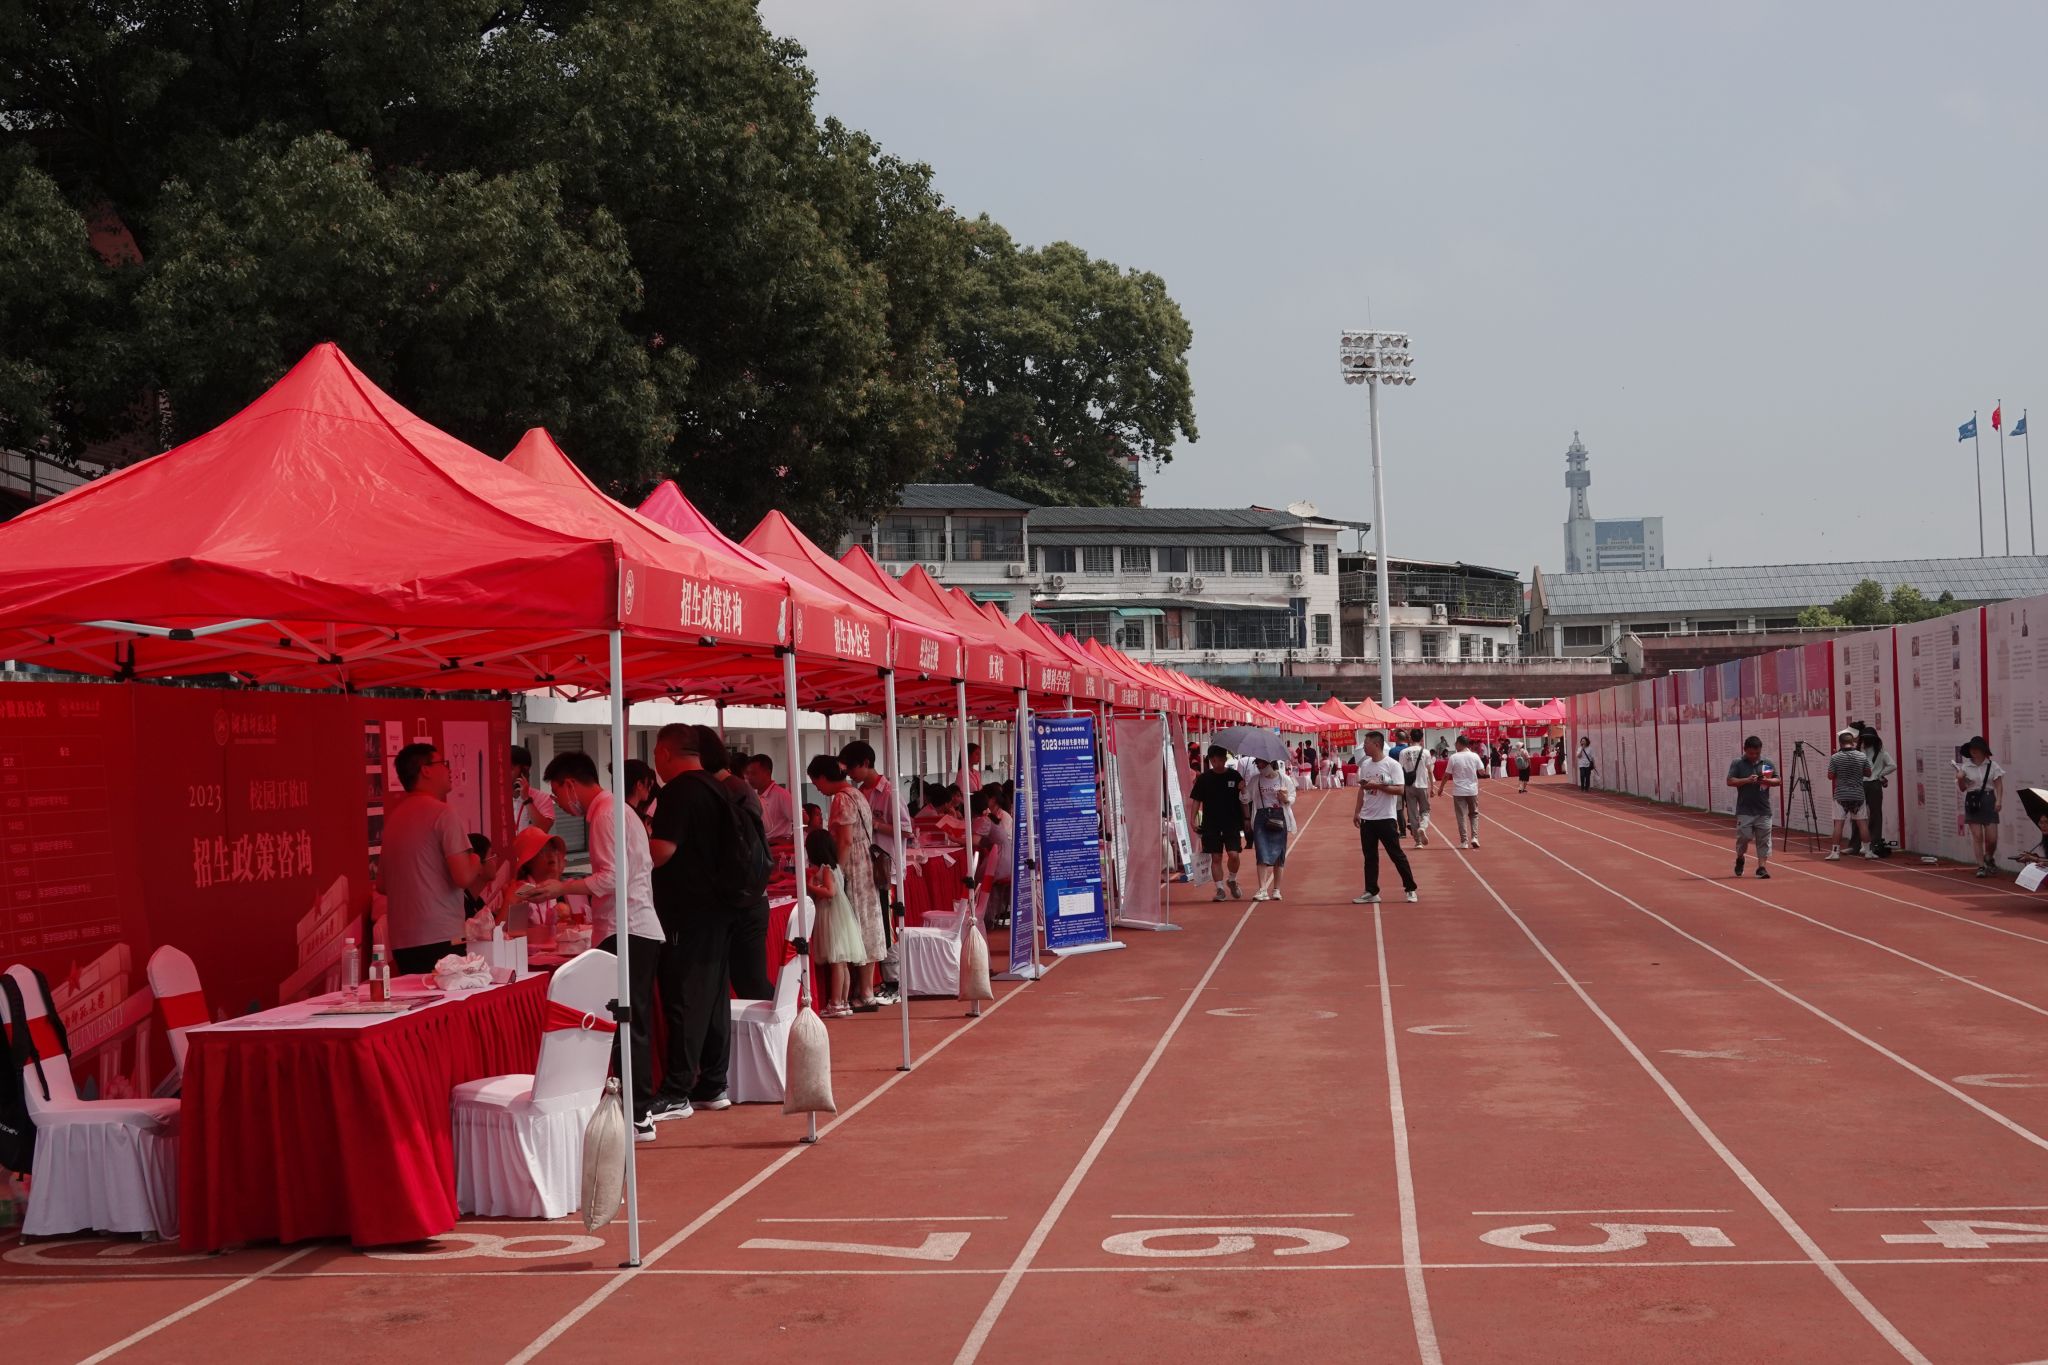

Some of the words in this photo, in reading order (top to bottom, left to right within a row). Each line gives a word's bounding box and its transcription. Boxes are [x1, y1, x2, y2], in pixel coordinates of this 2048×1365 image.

[680, 578, 743, 636] 招生政策咨询
[834, 616, 872, 658] 招生办公室
[187, 784, 223, 814] 2023
[249, 778, 308, 811] 校园开放日
[192, 828, 313, 889] 招生政策咨询
[739, 1231, 973, 1262] 7
[1101, 1226, 1350, 1257] 6
[1478, 1221, 1737, 1253] 5
[1880, 1220, 2048, 1249] 4
